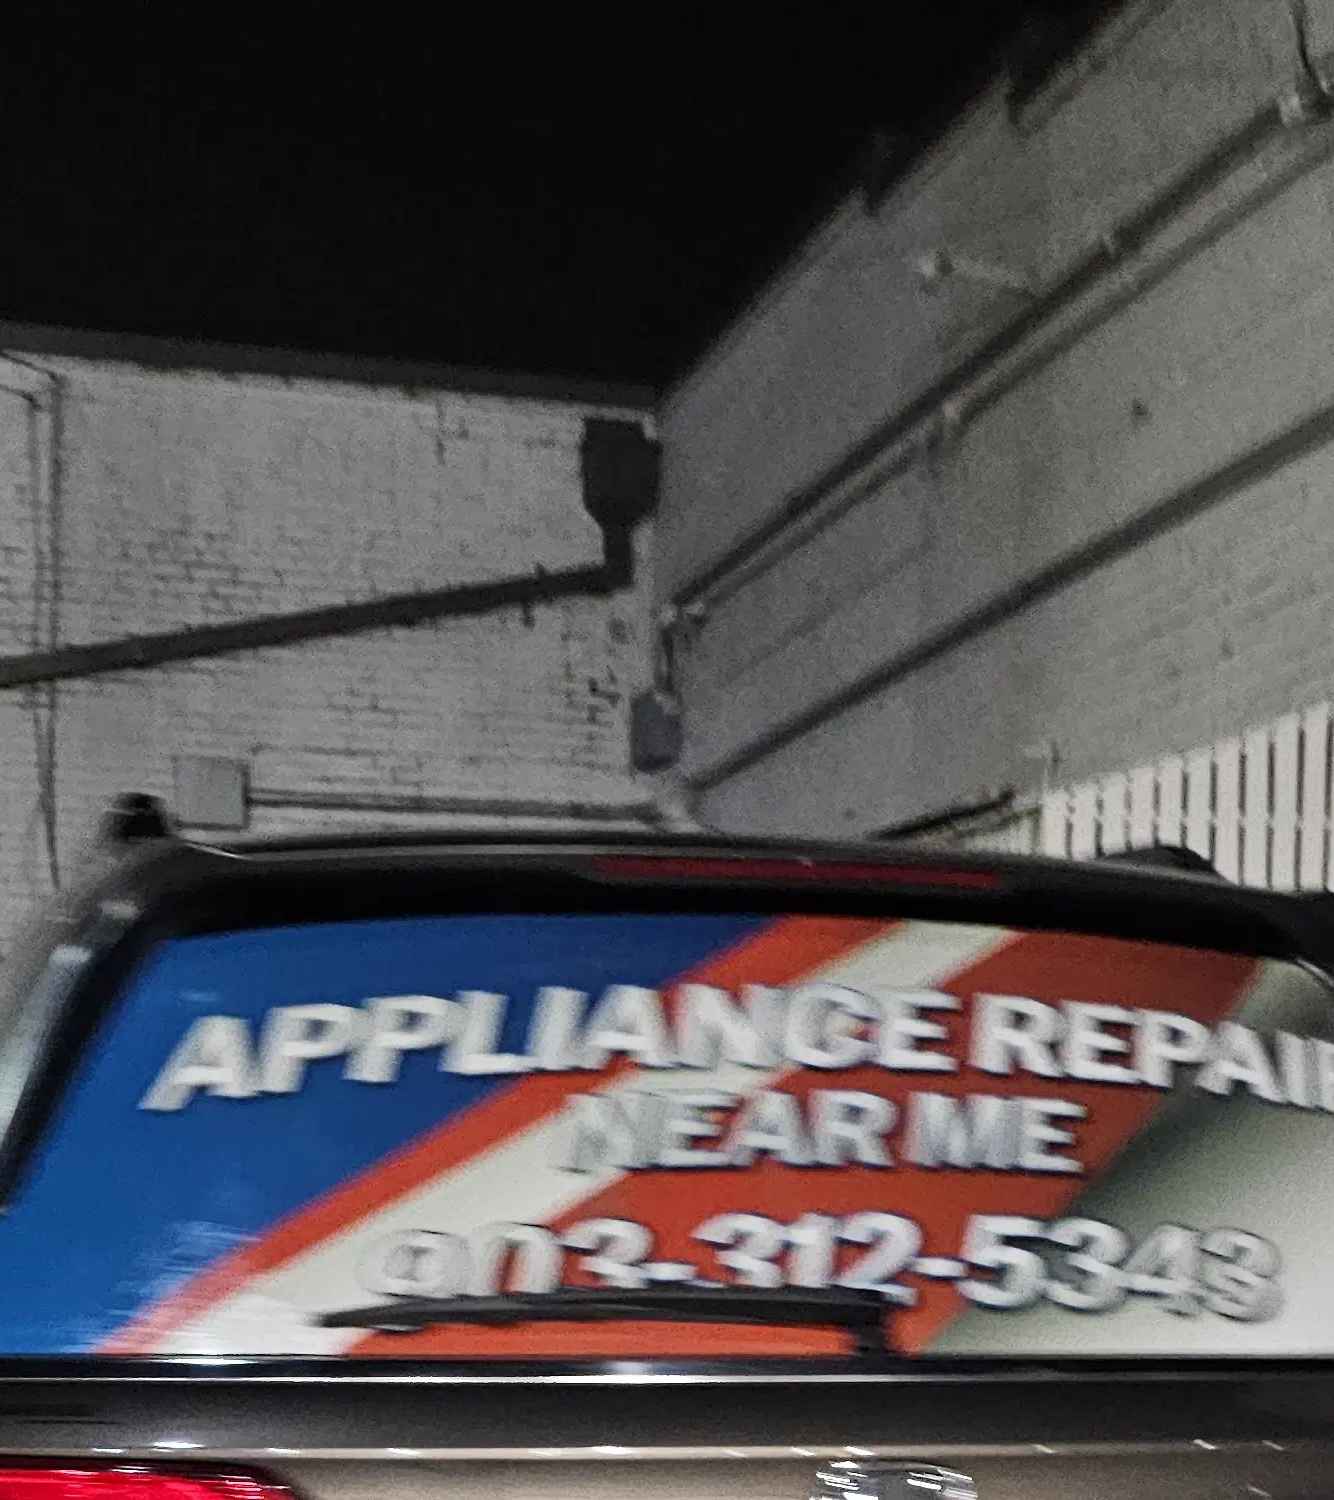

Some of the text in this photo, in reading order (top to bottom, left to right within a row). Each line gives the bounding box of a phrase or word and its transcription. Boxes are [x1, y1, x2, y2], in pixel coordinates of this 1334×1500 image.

[138, 982, 963, 1112] APPLIANCE
[557, 1086, 1089, 1174] NEAR ME
